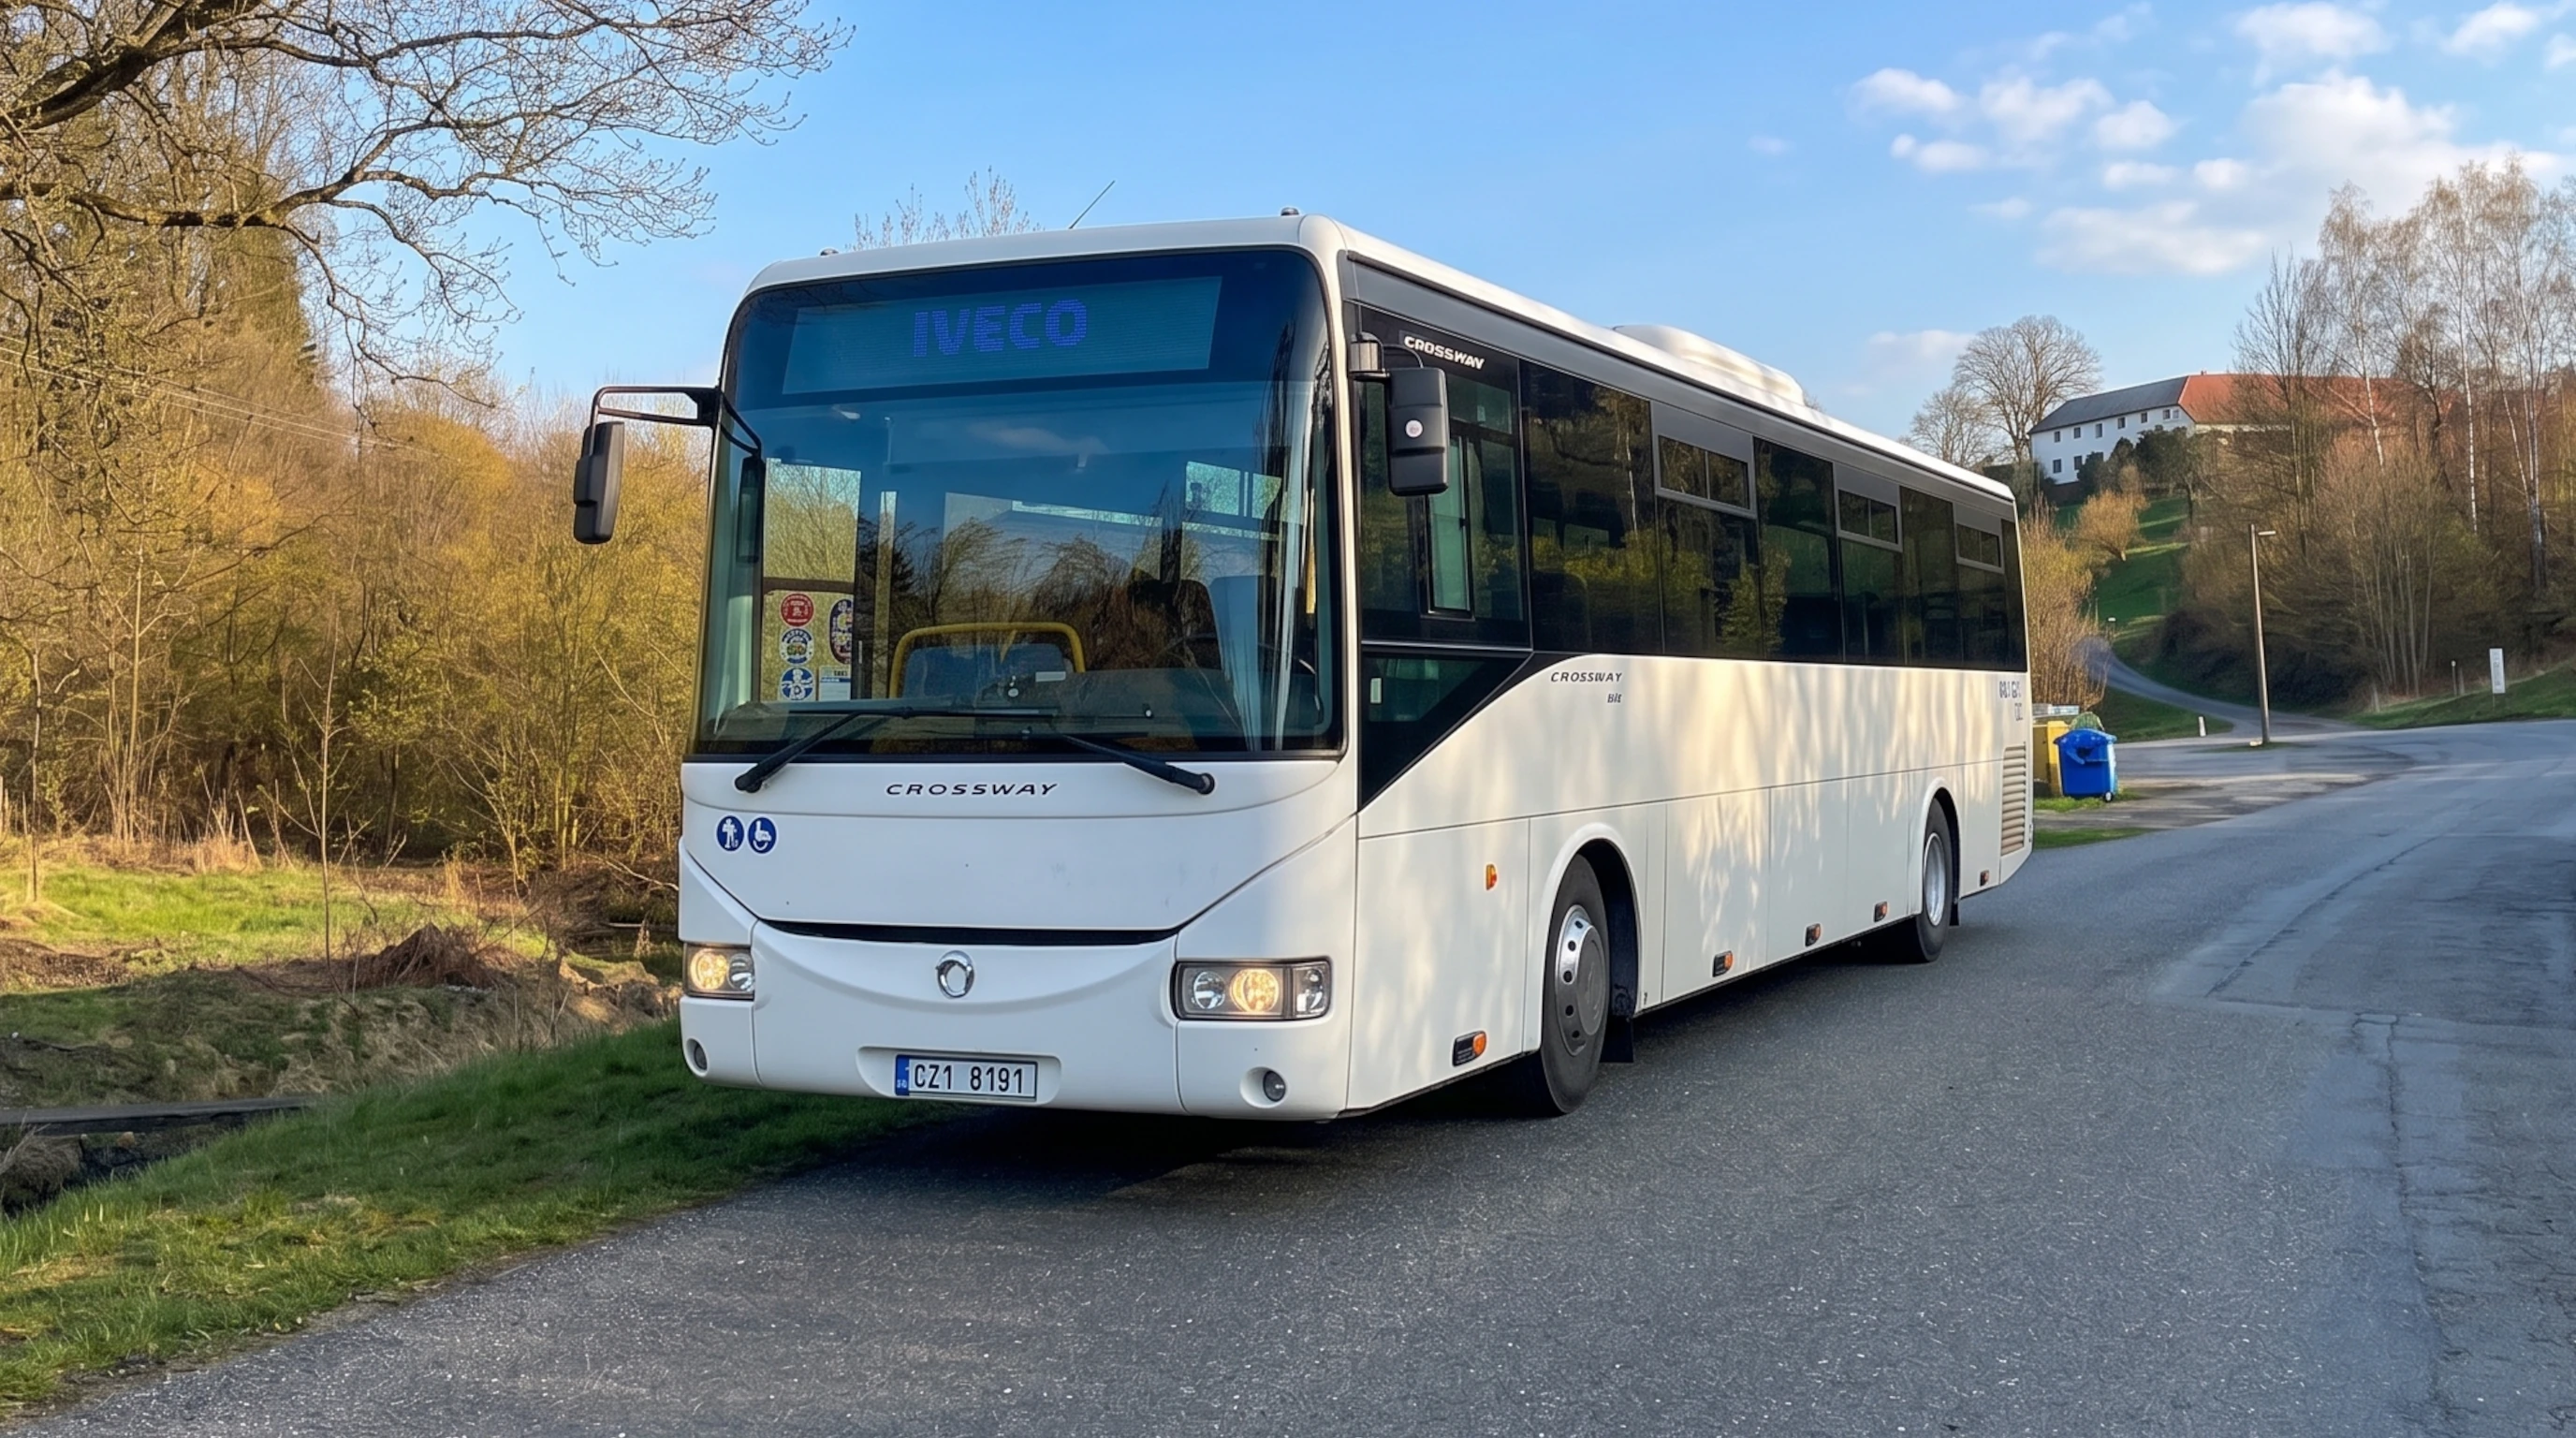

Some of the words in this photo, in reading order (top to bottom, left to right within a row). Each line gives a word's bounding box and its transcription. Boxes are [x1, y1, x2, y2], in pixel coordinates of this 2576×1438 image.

[914, 299, 1088, 358] IVECO
[1404, 335, 1486, 370] CROSSWAY
[1550, 671, 1623, 682] CROSSWAY
[886, 784, 1058, 796] CROSSWAY
[915, 1064, 952, 1090] CZ1
[970, 1065, 1022, 1093] 8191
